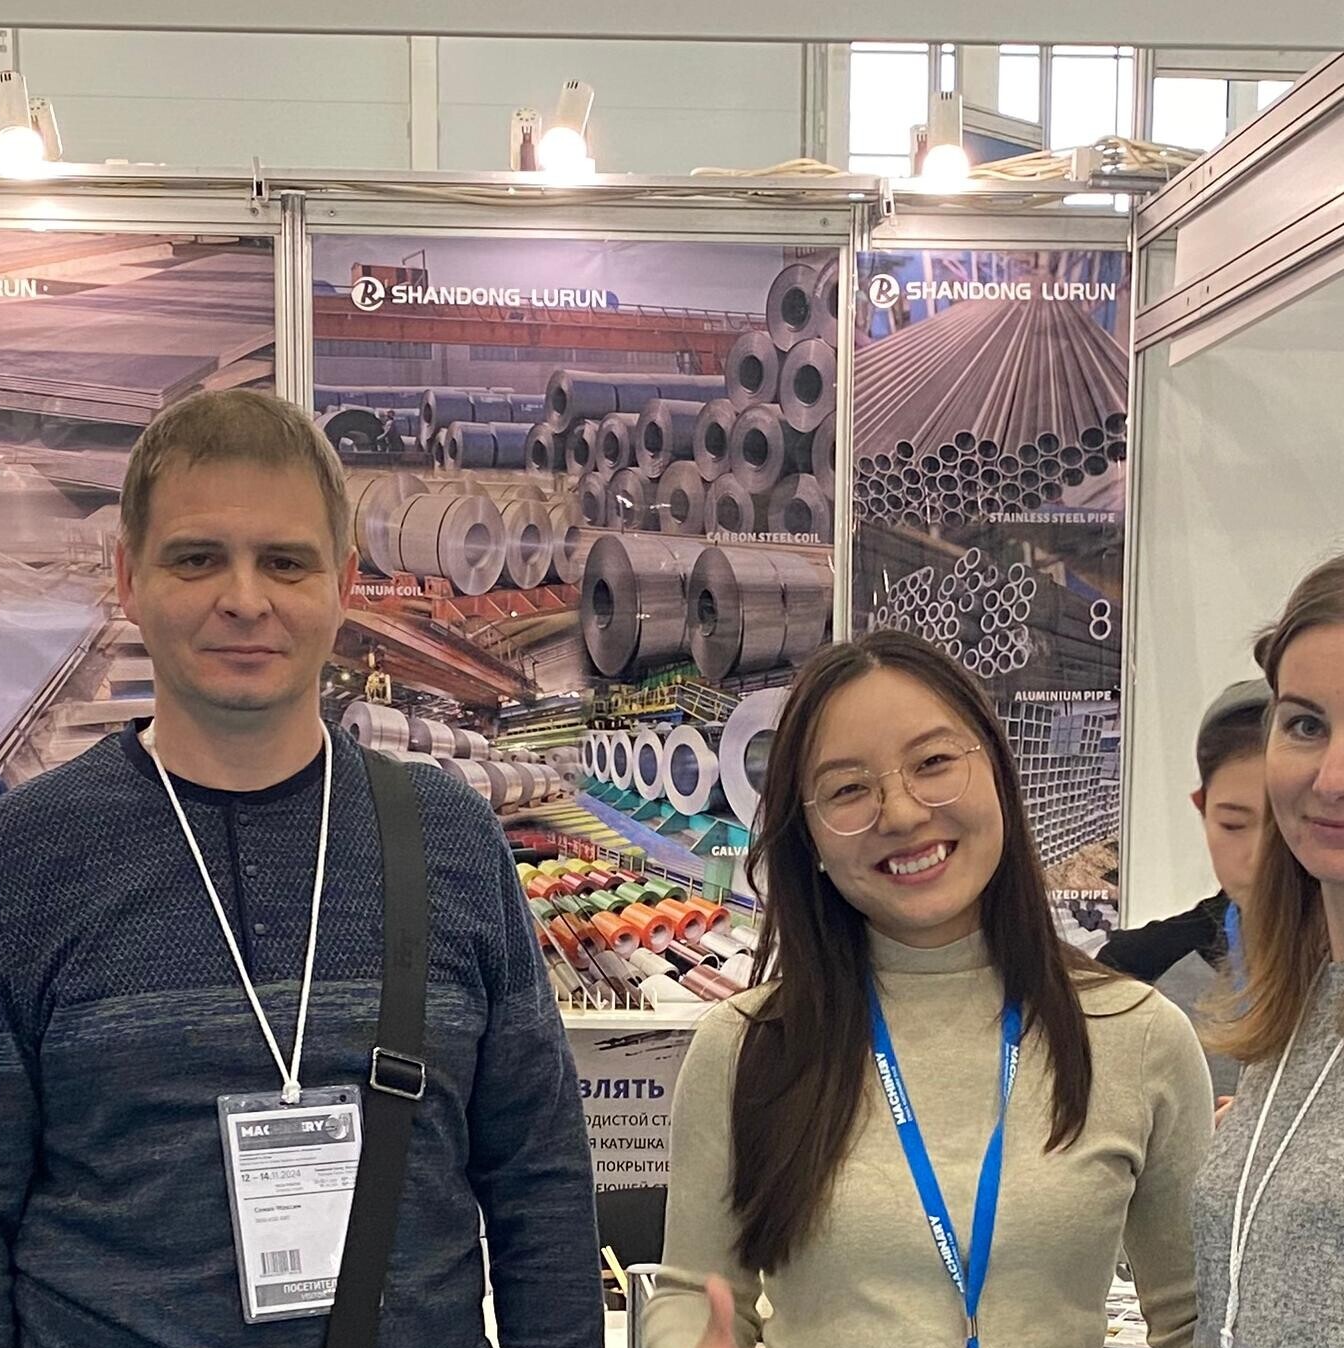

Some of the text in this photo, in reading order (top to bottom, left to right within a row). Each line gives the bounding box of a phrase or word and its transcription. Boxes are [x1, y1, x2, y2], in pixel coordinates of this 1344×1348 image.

[391, 285, 520, 307] SHANDONG
[530, 288, 607, 308] LURUN
[906, 280, 1031, 301] SHANDONG
[1042, 282, 1116, 301] LURUN
[989, 511, 1116, 524] STAINLESS STEEL PIPE
[706, 531, 821, 544] CARBON STEEL COIL
[396, 586, 424, 597] COIL
[1014, 690, 1112, 702] ALUMINIUM PIPE
[1081, 889, 1109, 900] PIPE
[601, 1138, 664, 1150] КАТУШКА
[597, 1161, 670, 1172] ПОКРЫТИЕ
[241, 1174, 250, 1183] 12
